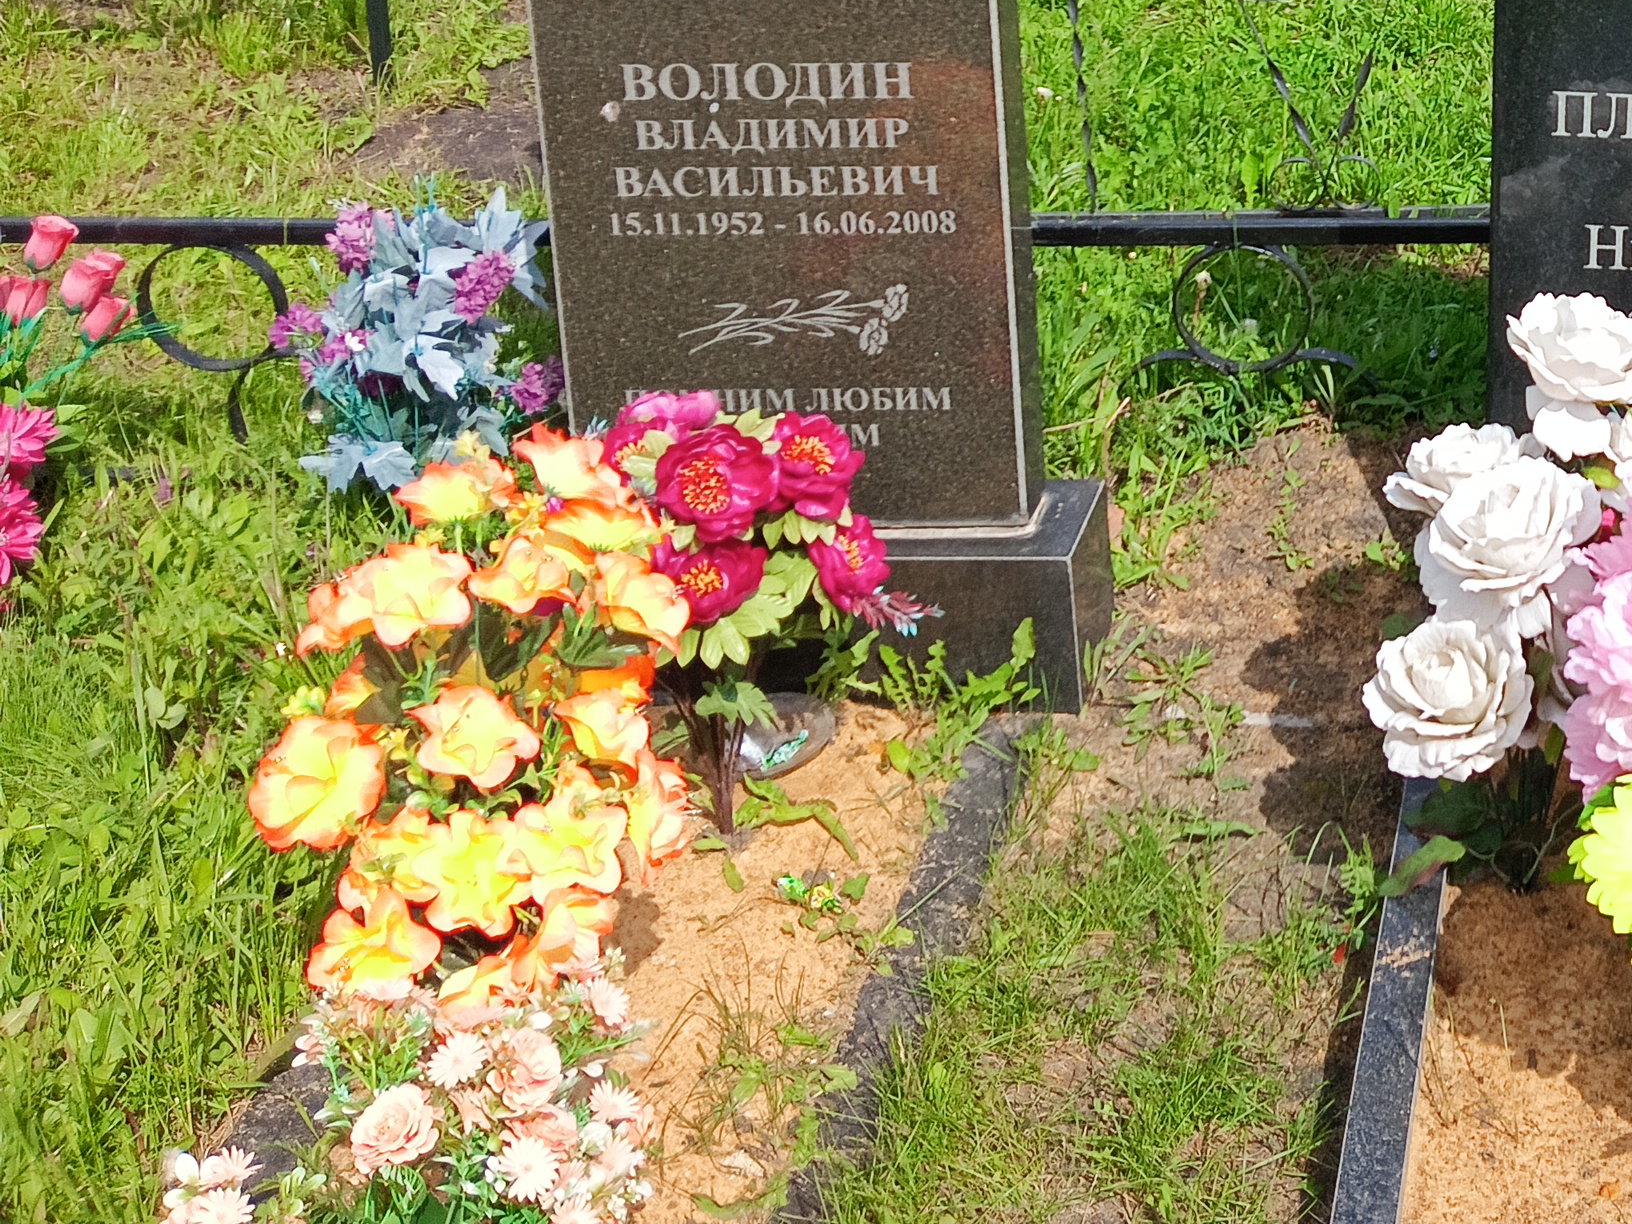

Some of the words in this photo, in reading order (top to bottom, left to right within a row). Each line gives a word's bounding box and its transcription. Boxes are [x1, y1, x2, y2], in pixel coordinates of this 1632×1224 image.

[620, 62, 915, 108] ВОЛОДИН
[635, 117, 910, 155] ВЛАДИМИР
[613, 164, 941, 198] ВАСИЛЬЕВИЧ
[609, 210, 765, 236] 15.11.1952
[797, 209, 957, 235] 16.06.2008
[624, 387, 796, 413] ПНИМ
[805, 386, 952, 412] ЛЮБИМ
